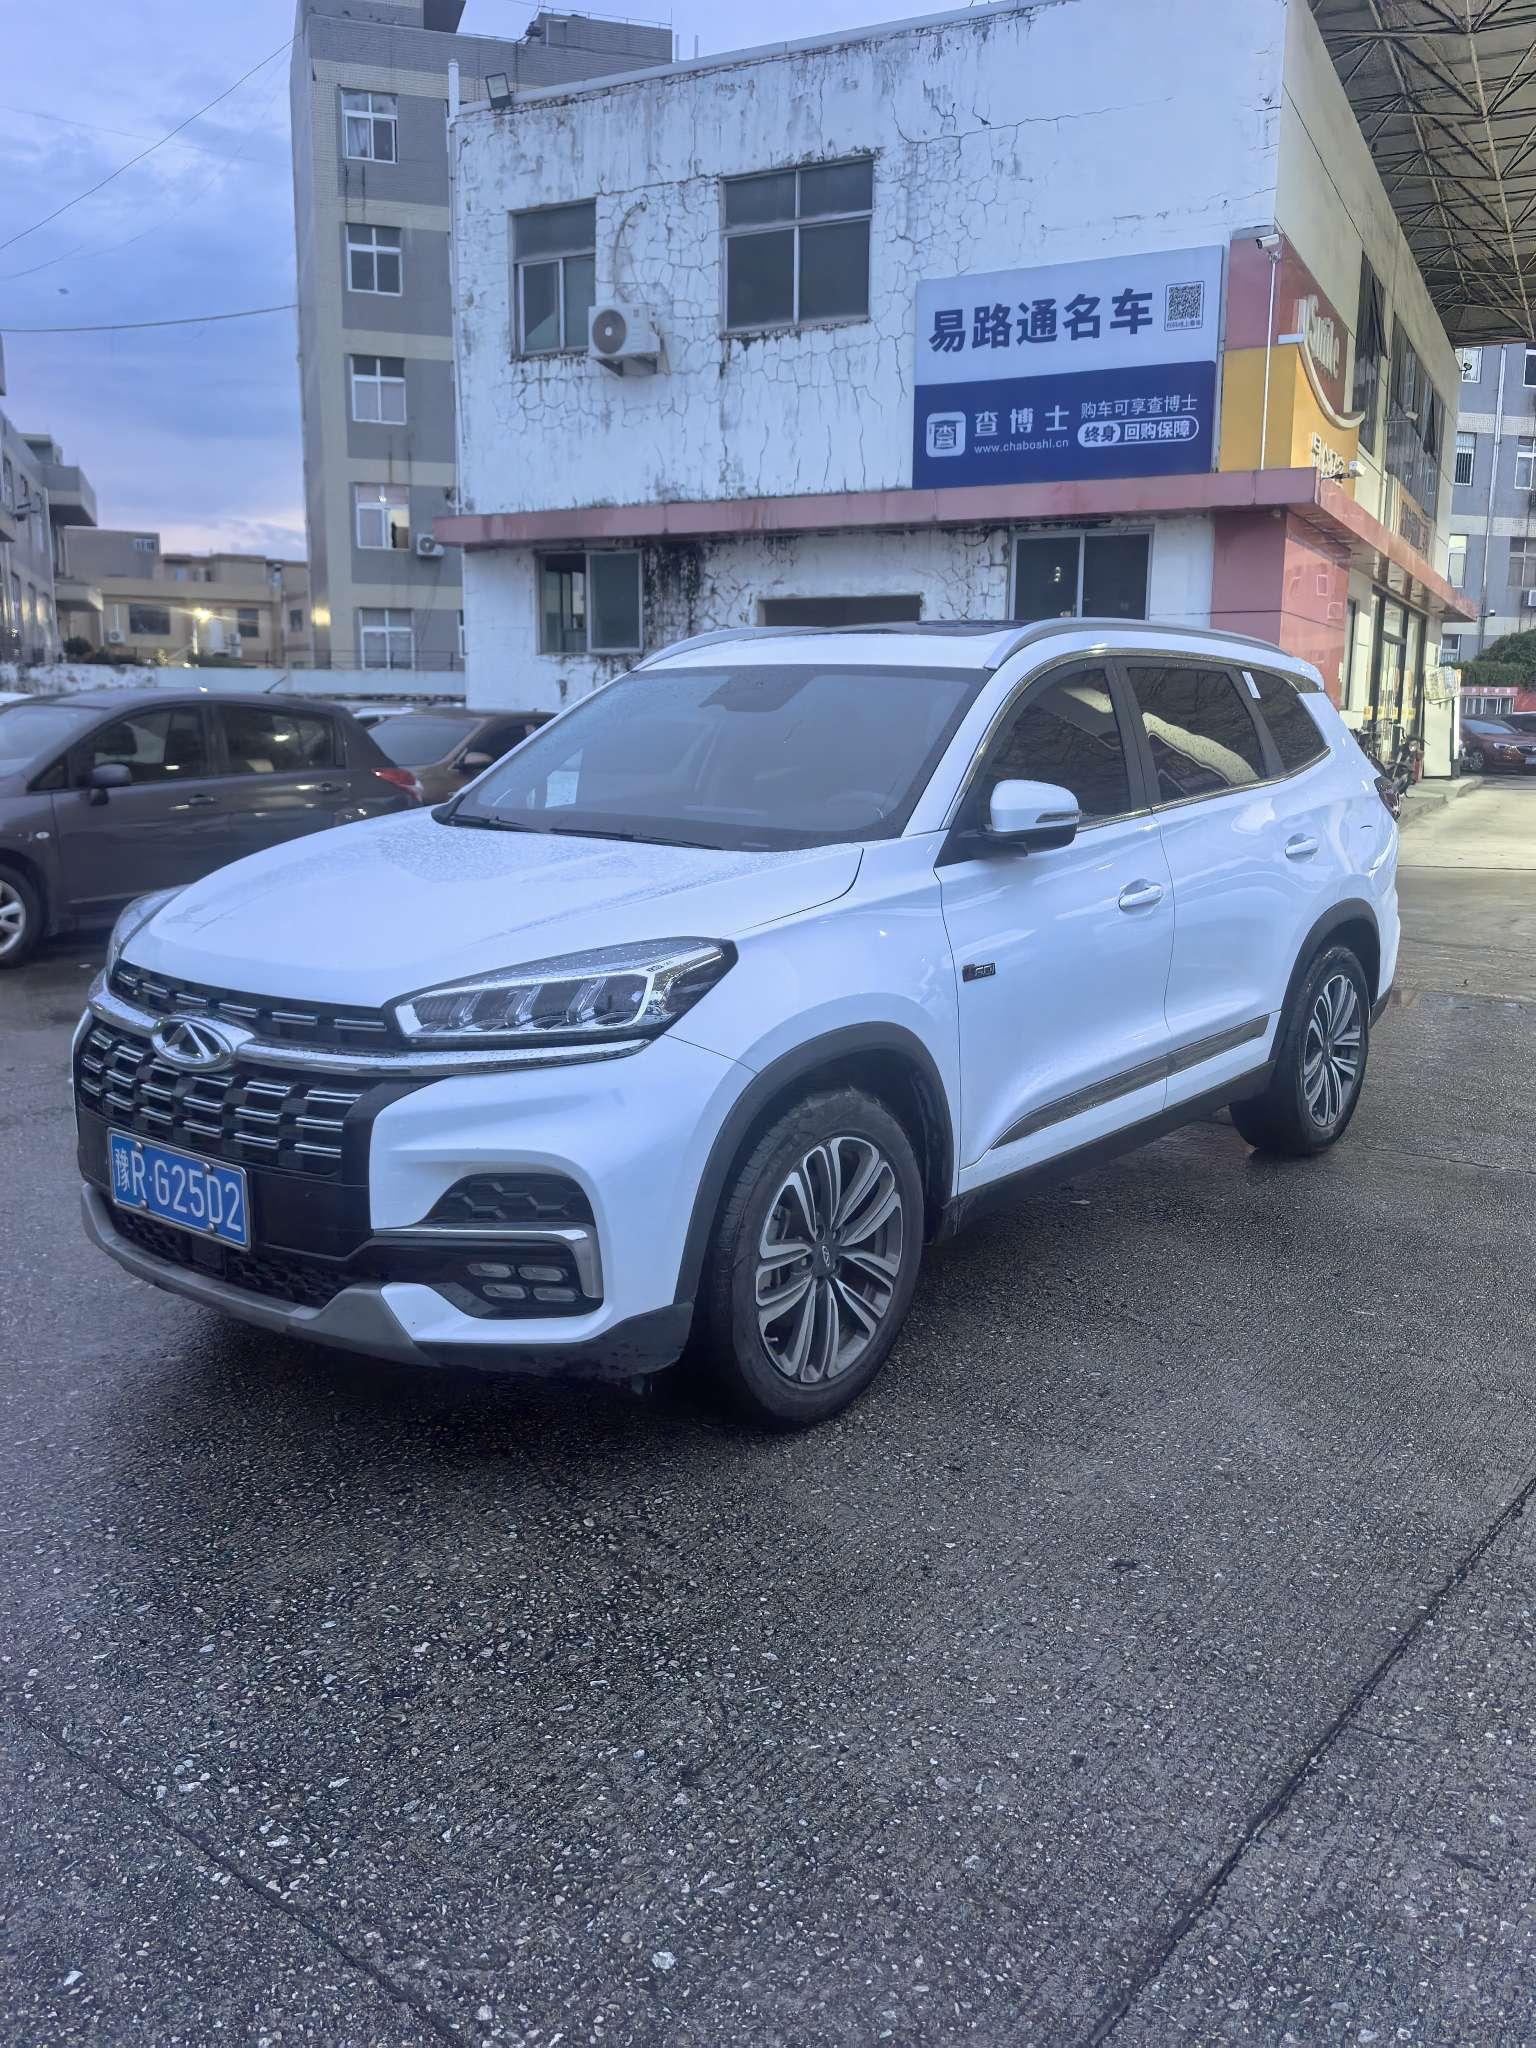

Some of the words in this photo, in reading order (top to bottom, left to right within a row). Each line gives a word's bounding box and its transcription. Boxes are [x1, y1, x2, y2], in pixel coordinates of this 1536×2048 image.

[929, 288, 1153, 353] 易路通名车
[1081, 394, 1197, 419] 购车可享查博士
[974, 405, 1070, 437] 查博士
[1124, 421, 1191, 441] 回购保障
[974, 438, 1069, 454] www.chaboshi.cn
